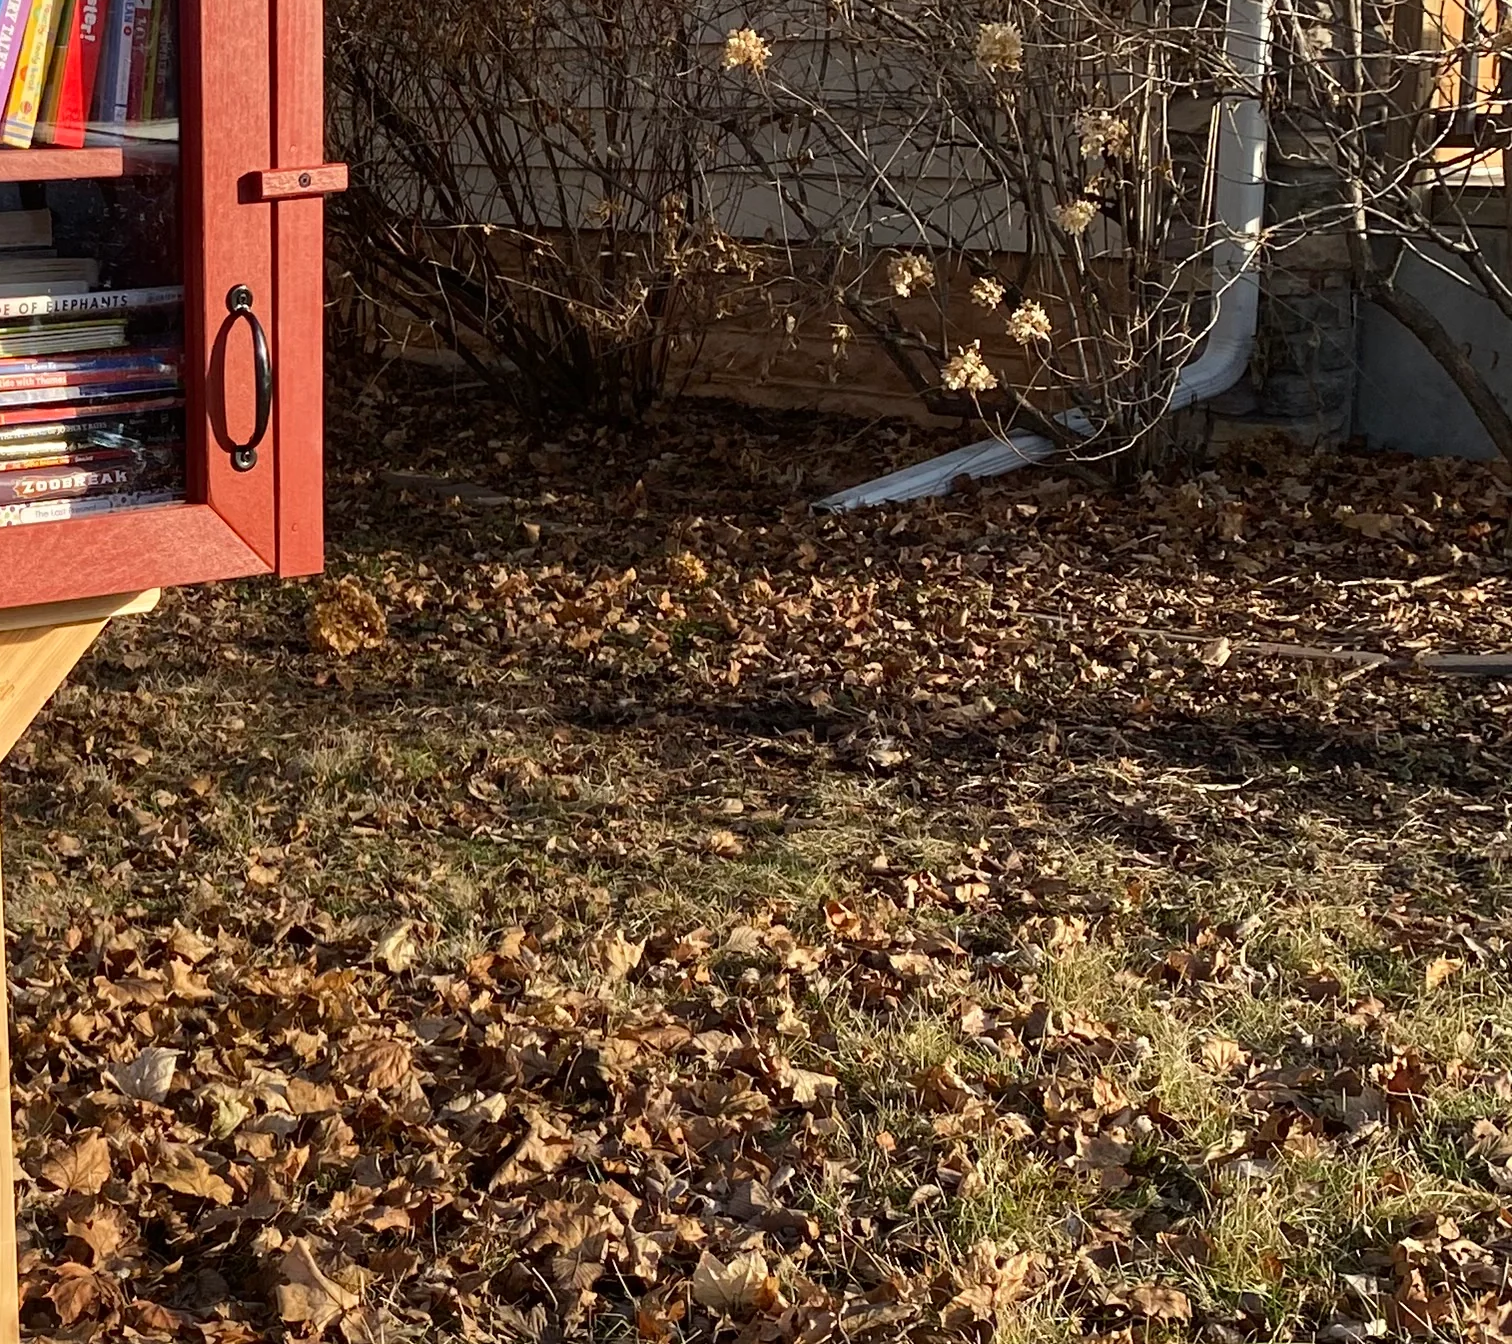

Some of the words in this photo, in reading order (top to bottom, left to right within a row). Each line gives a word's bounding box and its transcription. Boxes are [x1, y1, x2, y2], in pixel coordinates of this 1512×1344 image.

[19, 302, 37, 315] OF
[46, 295, 128, 313] ELEPHANTS
[22, 470, 128, 494] ZOOBREAK
[35, 510, 49, 519] The
